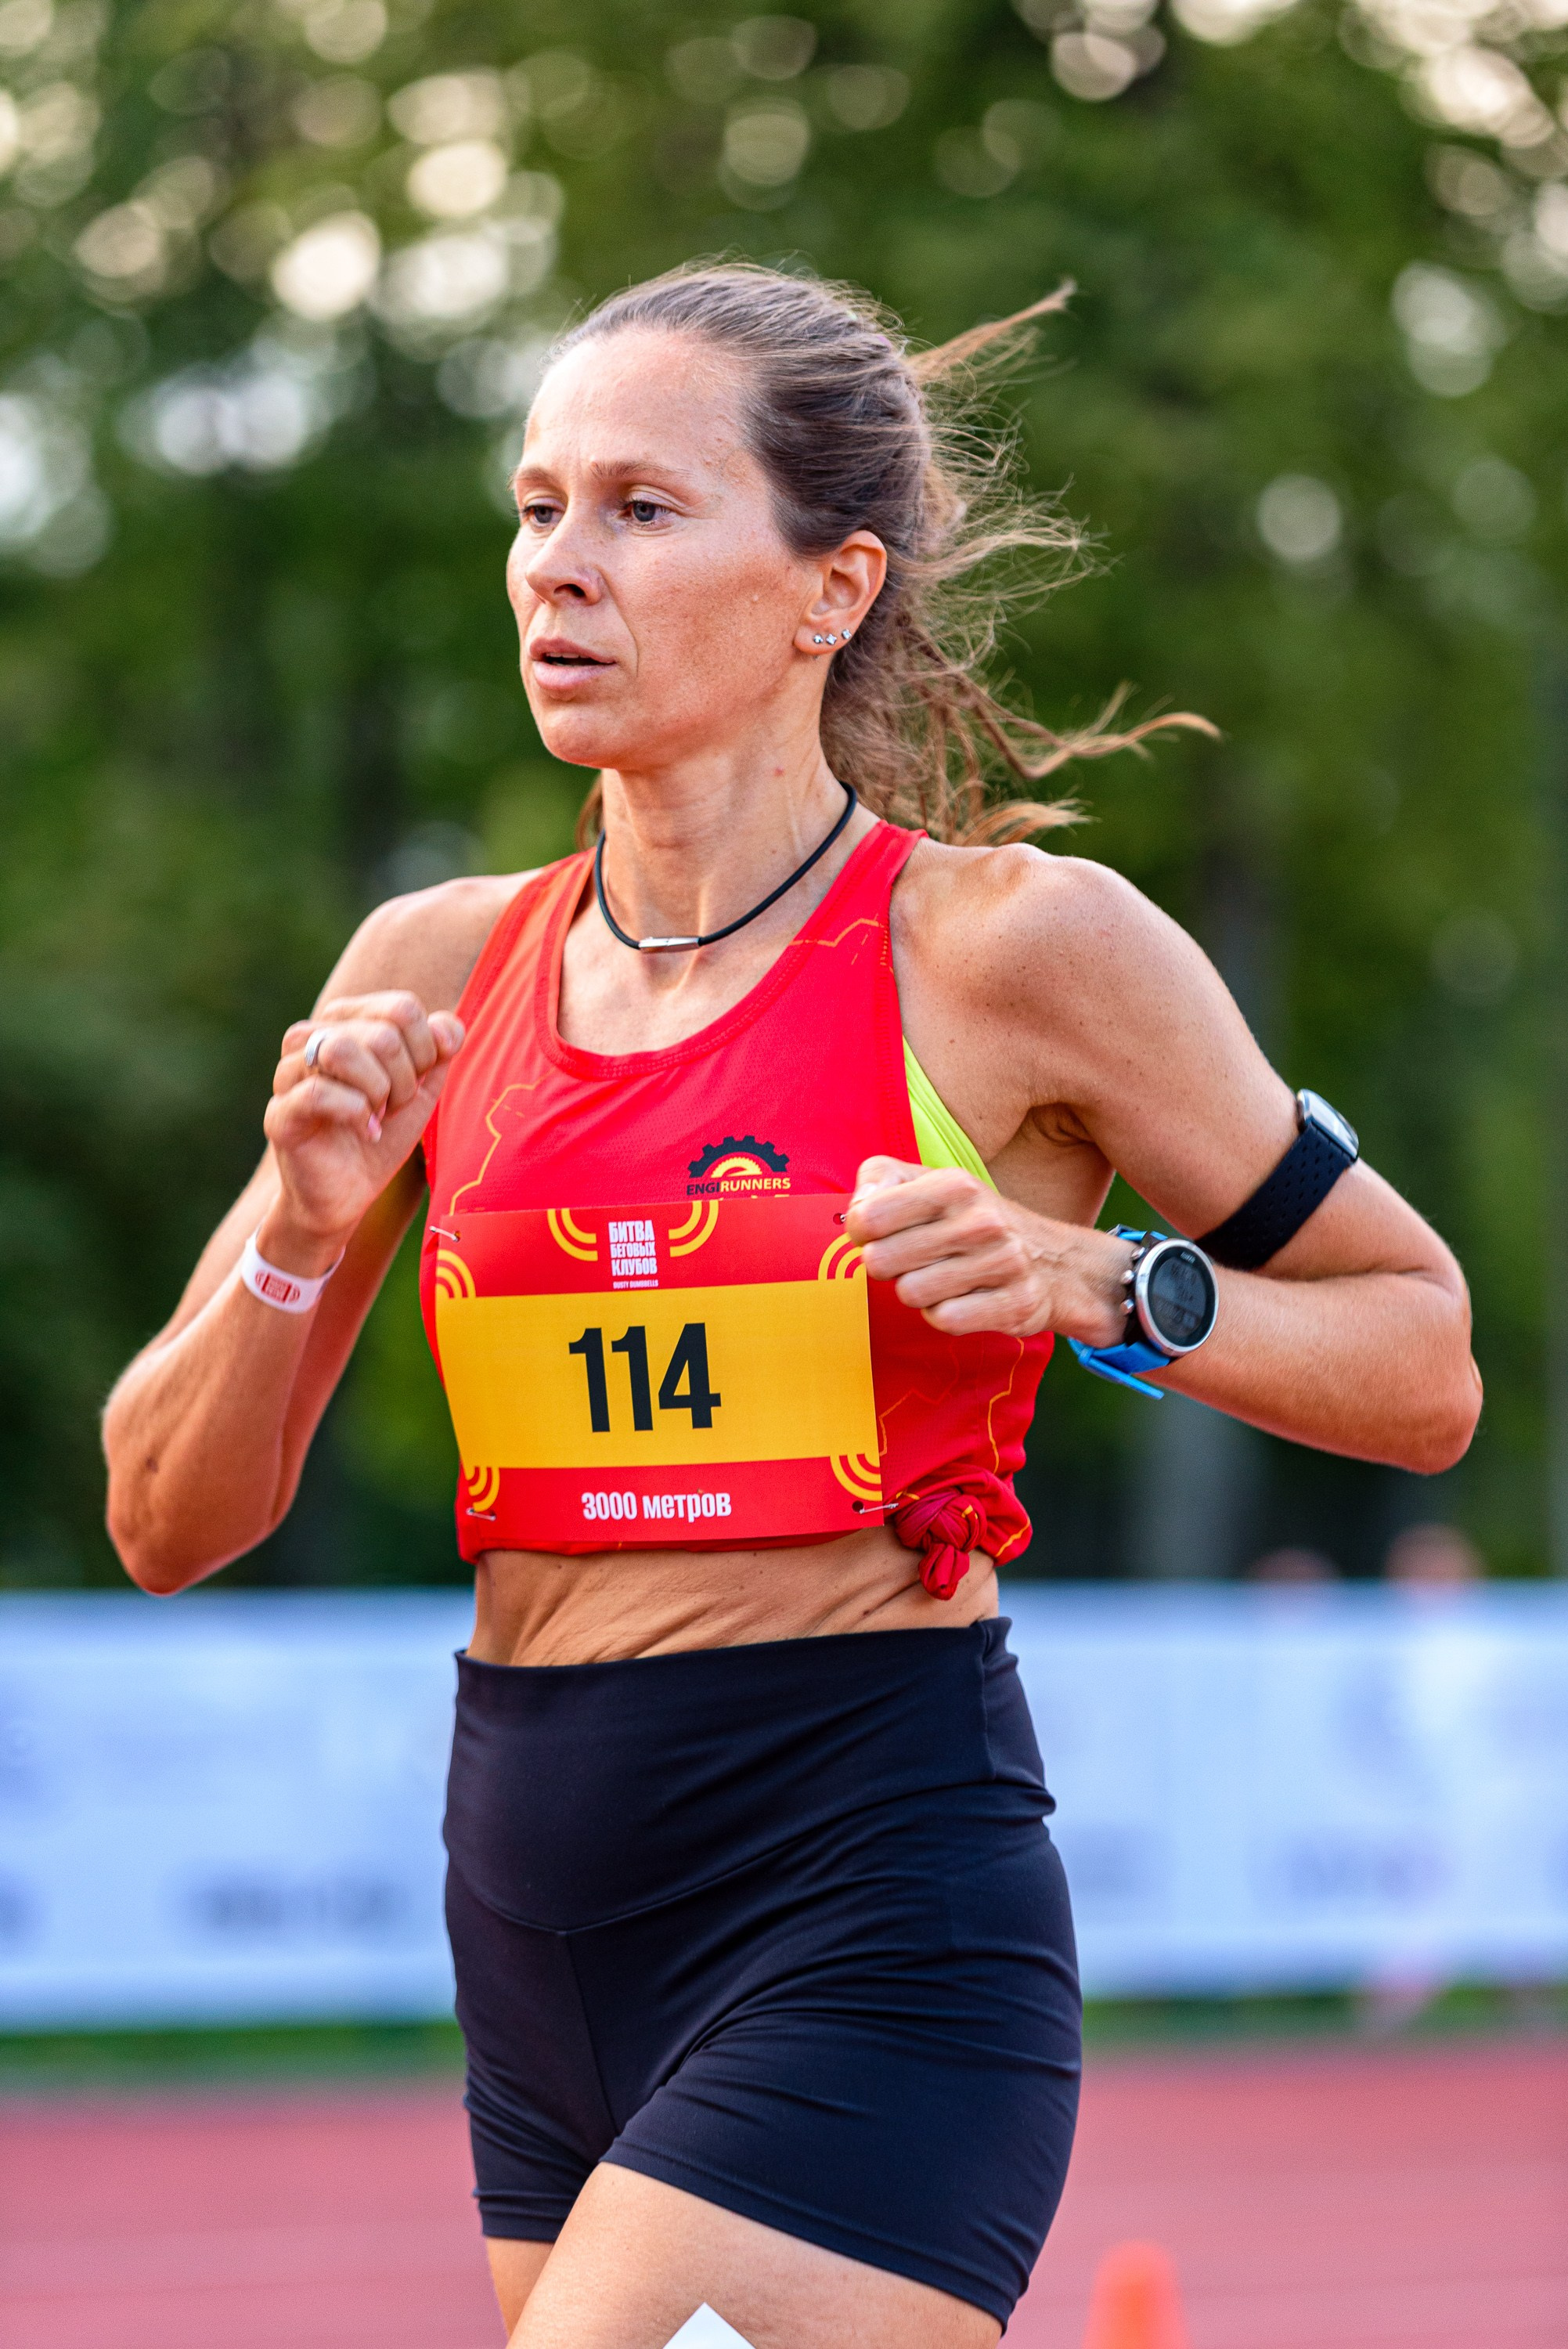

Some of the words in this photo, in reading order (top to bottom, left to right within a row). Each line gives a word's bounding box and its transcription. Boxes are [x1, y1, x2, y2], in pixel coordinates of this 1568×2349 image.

[687, 1178, 791, 1195] ENGIRUNNERS
[608, 1220, 654, 1243] БИТВА
[610, 1242, 656, 1258] БЕГОВЫХ
[611, 1257, 658, 1276] КЛУБОВ
[569, 1322, 721, 1432] 114
[581, 1492, 637, 1520] 3000
[642, 1492, 731, 1522] метров
